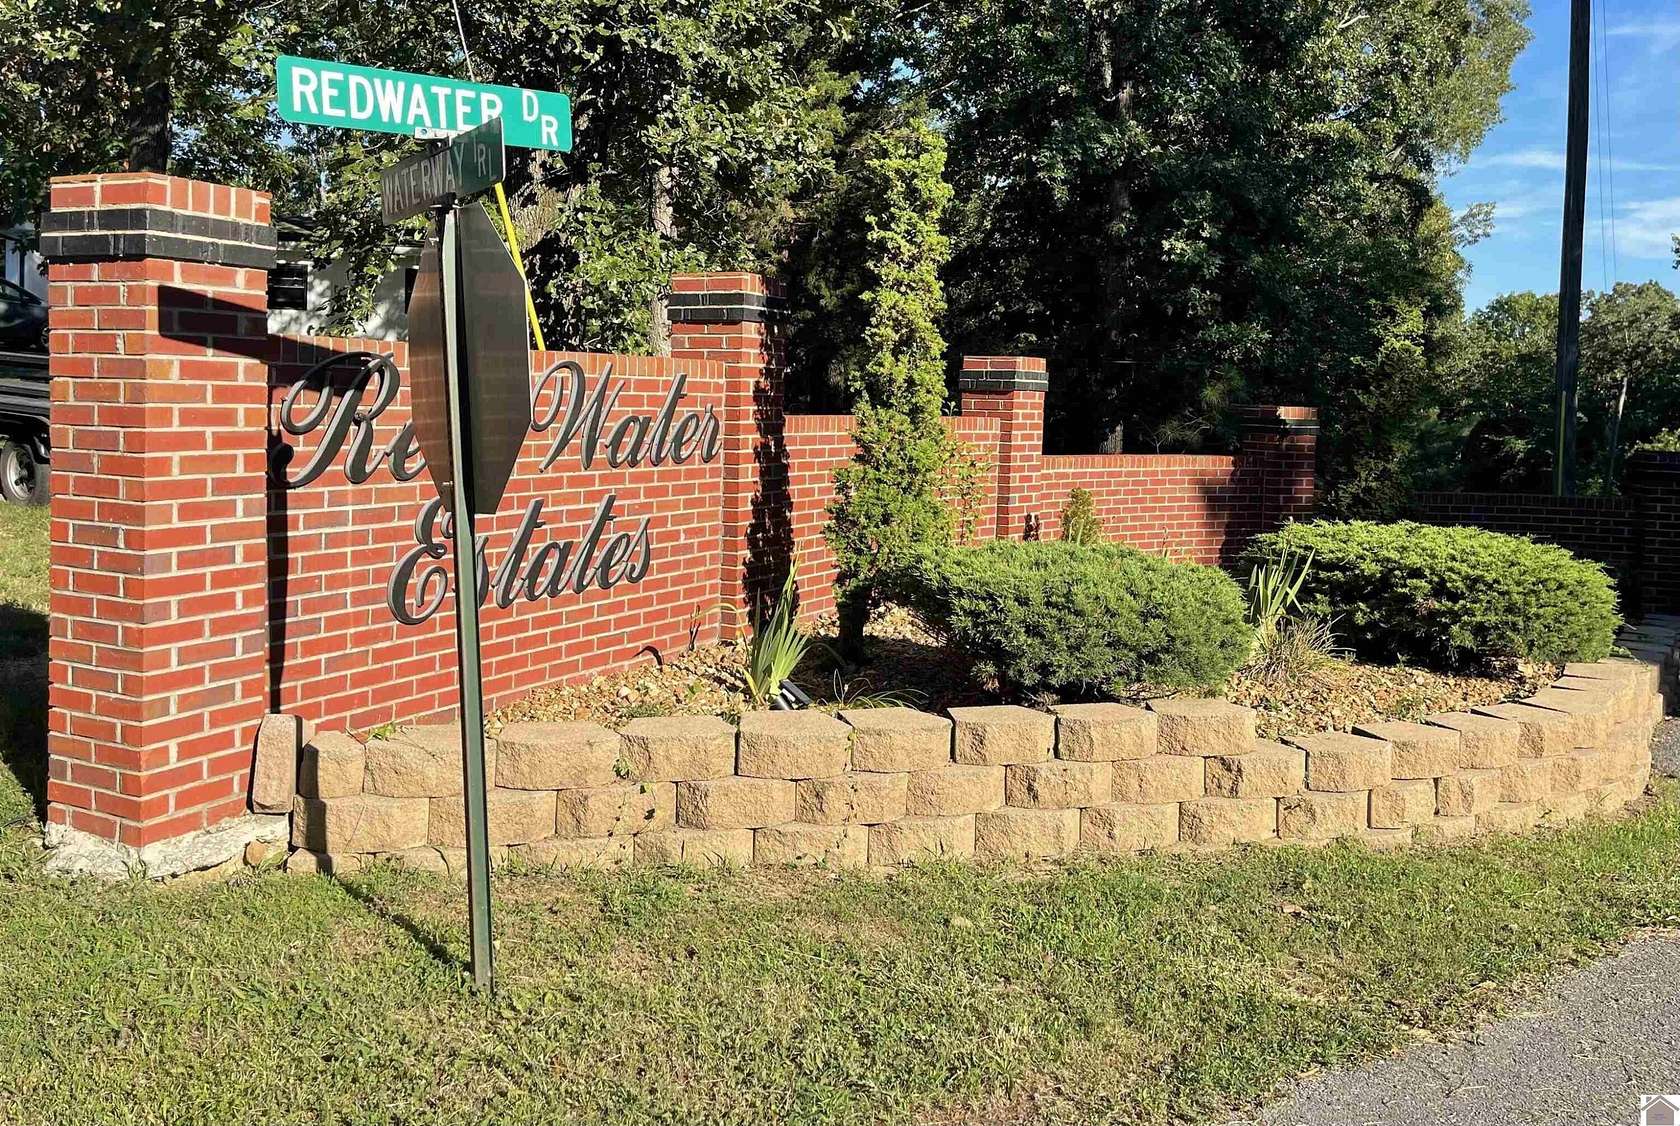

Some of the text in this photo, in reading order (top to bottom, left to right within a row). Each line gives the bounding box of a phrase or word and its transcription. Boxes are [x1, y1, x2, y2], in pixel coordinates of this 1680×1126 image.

[291, 66, 558, 146] REDWATER DR
[383, 142, 464, 216] WATERWAY
[266, 351, 722, 486] Re Water
